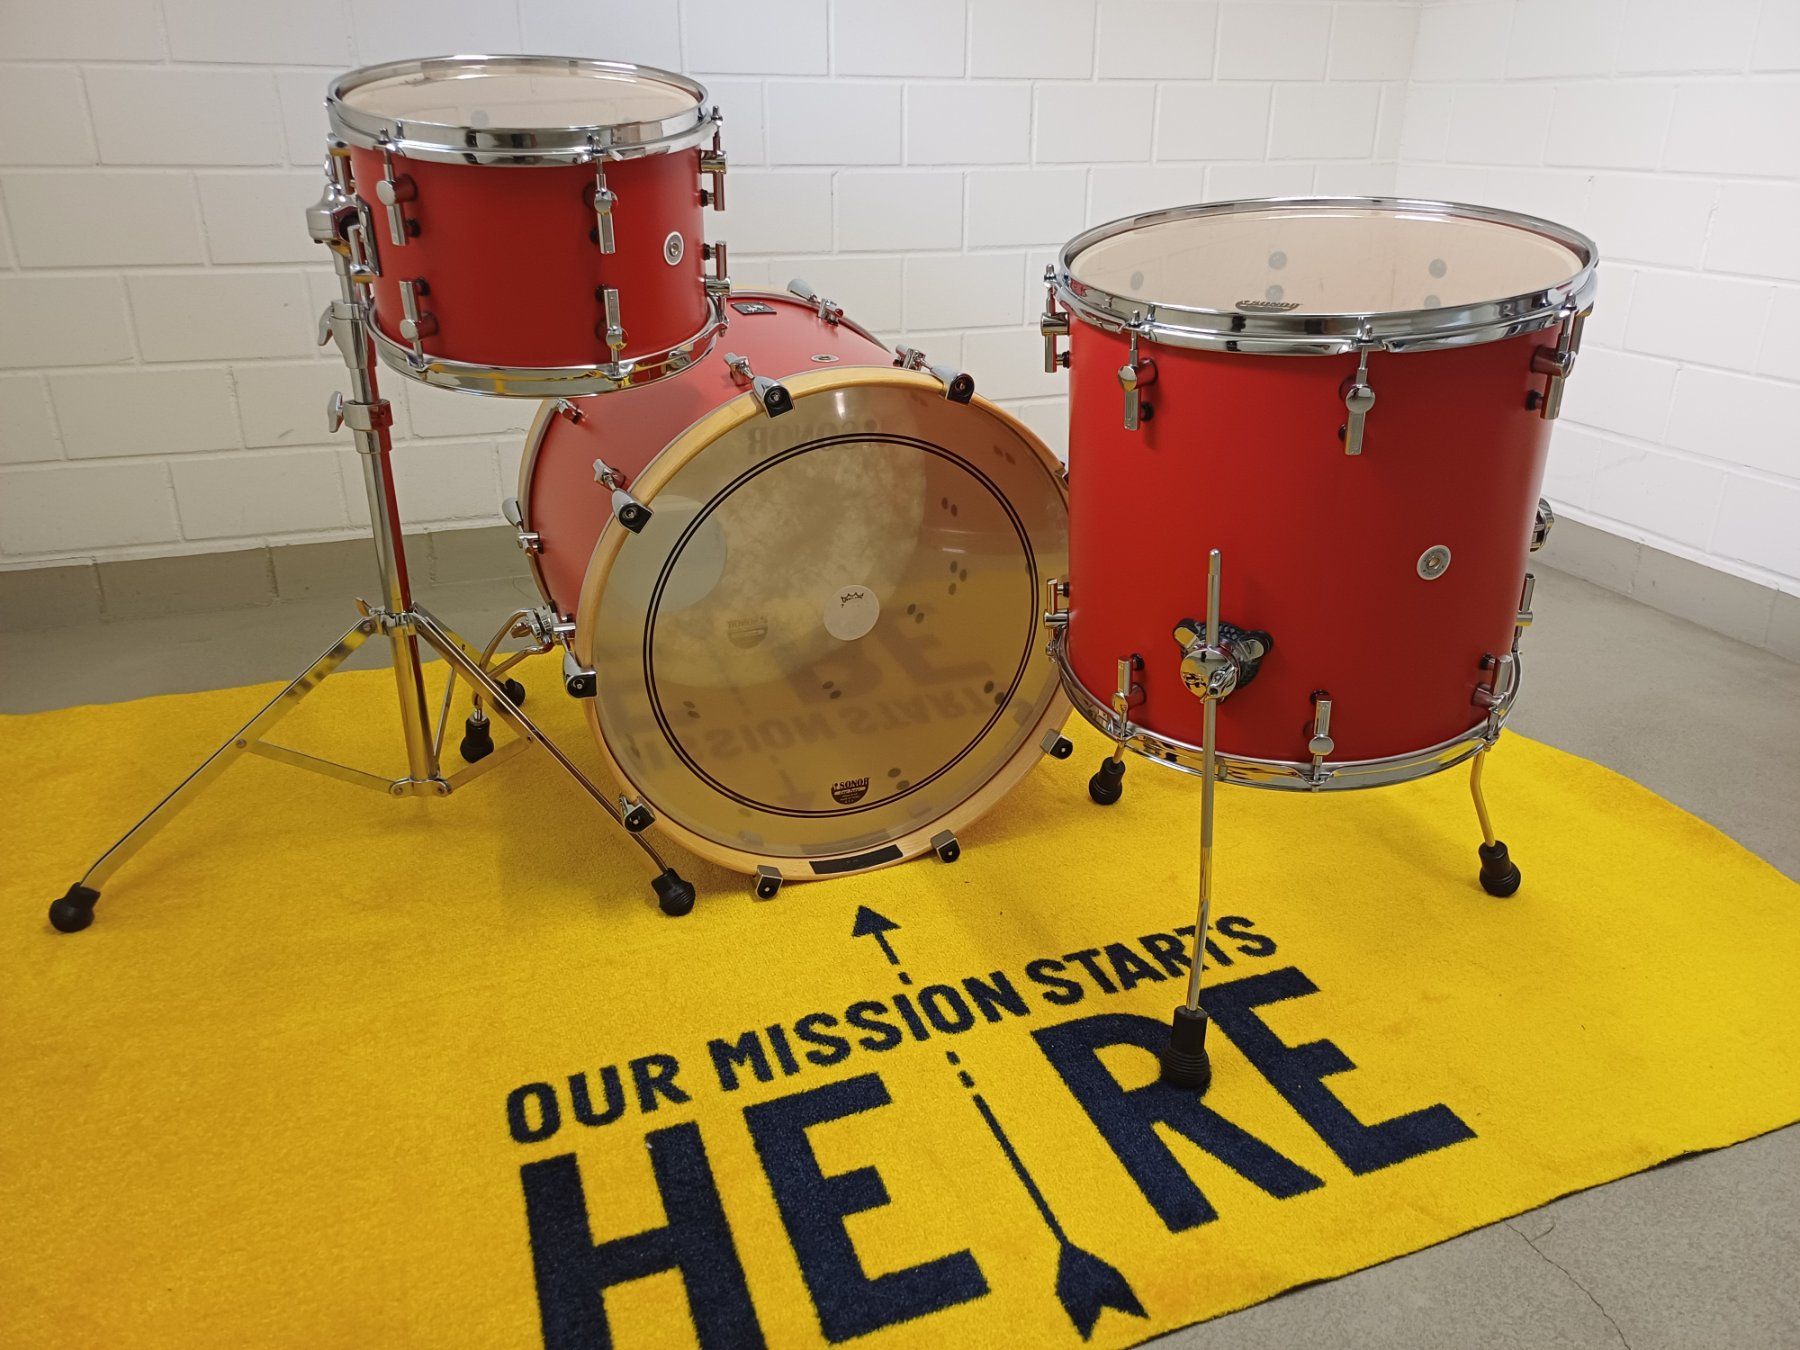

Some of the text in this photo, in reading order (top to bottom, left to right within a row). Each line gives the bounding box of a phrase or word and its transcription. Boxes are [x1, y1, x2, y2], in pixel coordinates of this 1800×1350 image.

[507, 915, 1278, 1145] OUR MISSION STARTS
